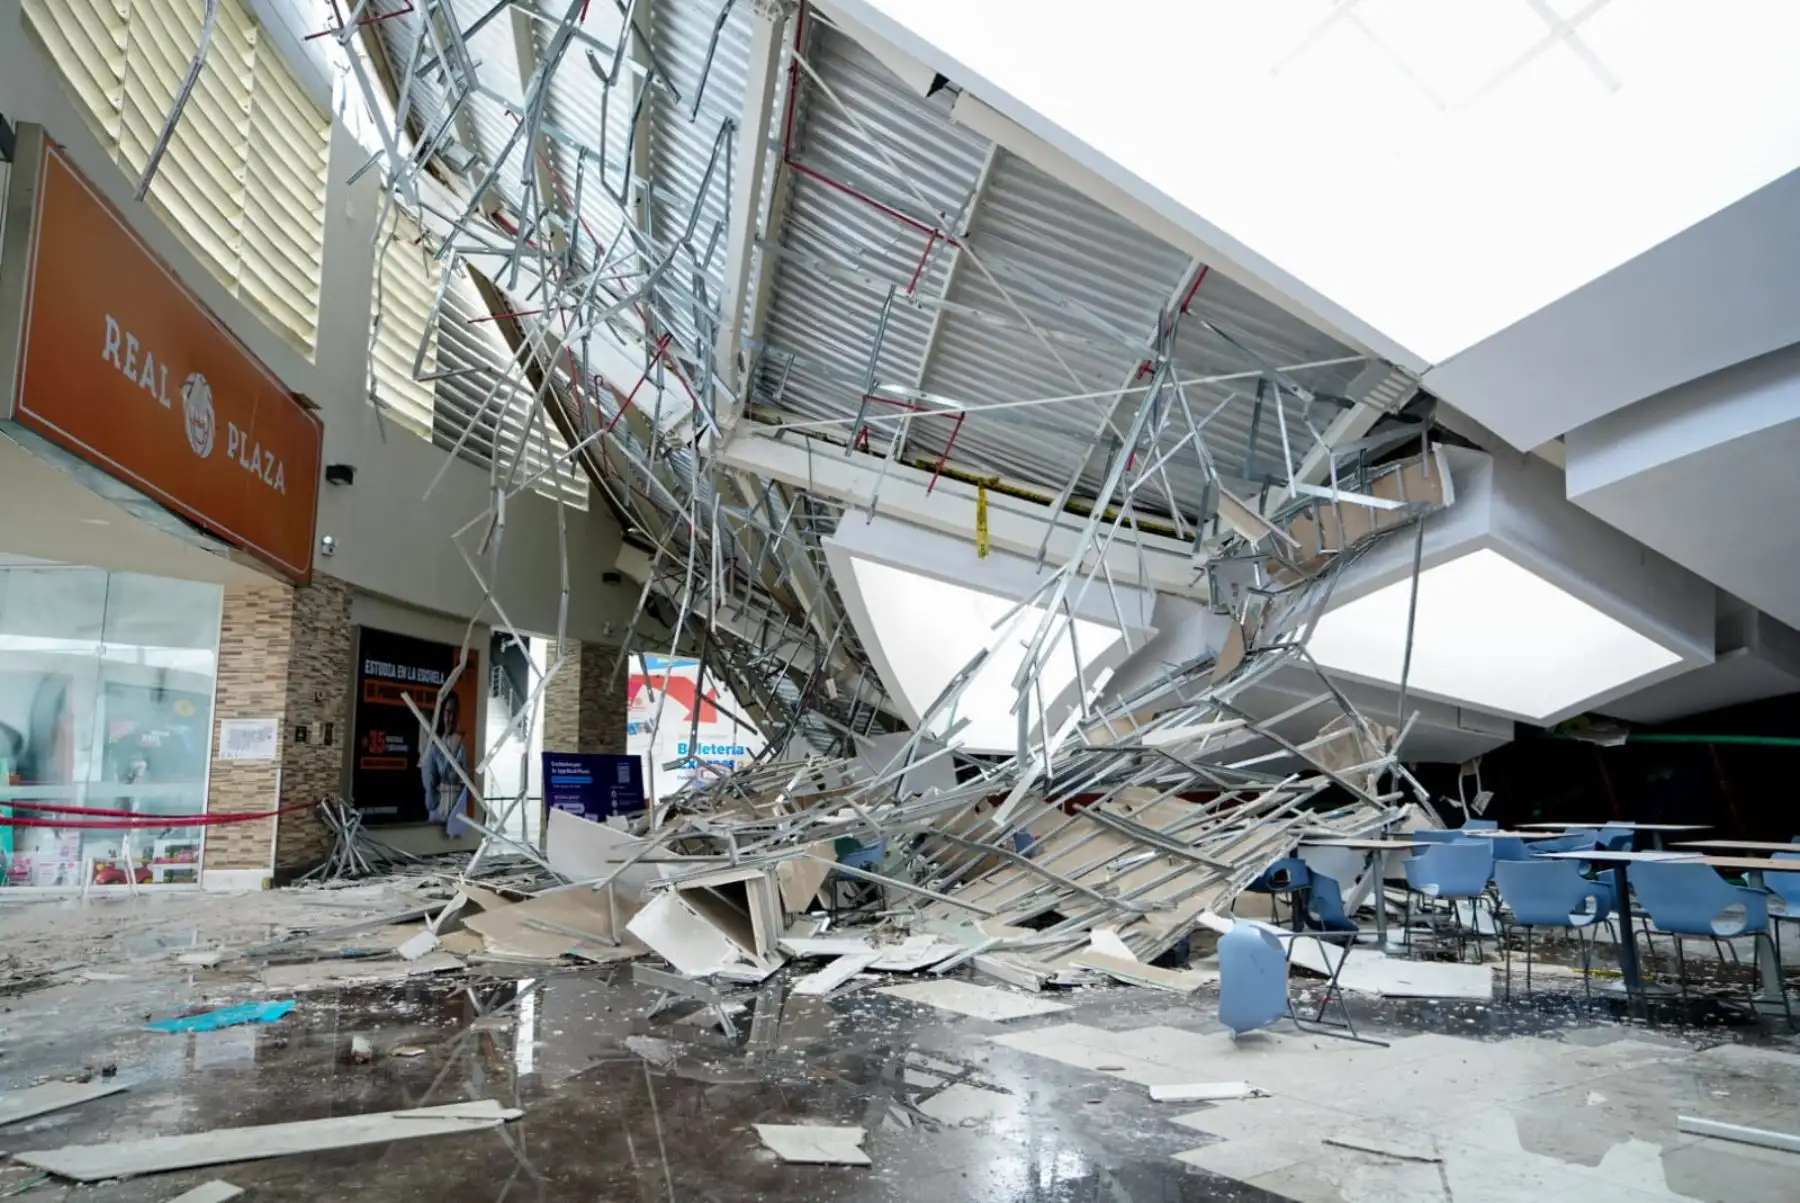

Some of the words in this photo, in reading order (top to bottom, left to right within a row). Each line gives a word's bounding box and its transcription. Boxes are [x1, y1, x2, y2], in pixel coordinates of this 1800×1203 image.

[102, 313, 173, 410] REAL
[226, 421, 287, 497] PLAZA
[364, 659, 397, 678] ESTUDIA
[397, 664, 408, 680] EN
[408, 665, 417, 681] LA
